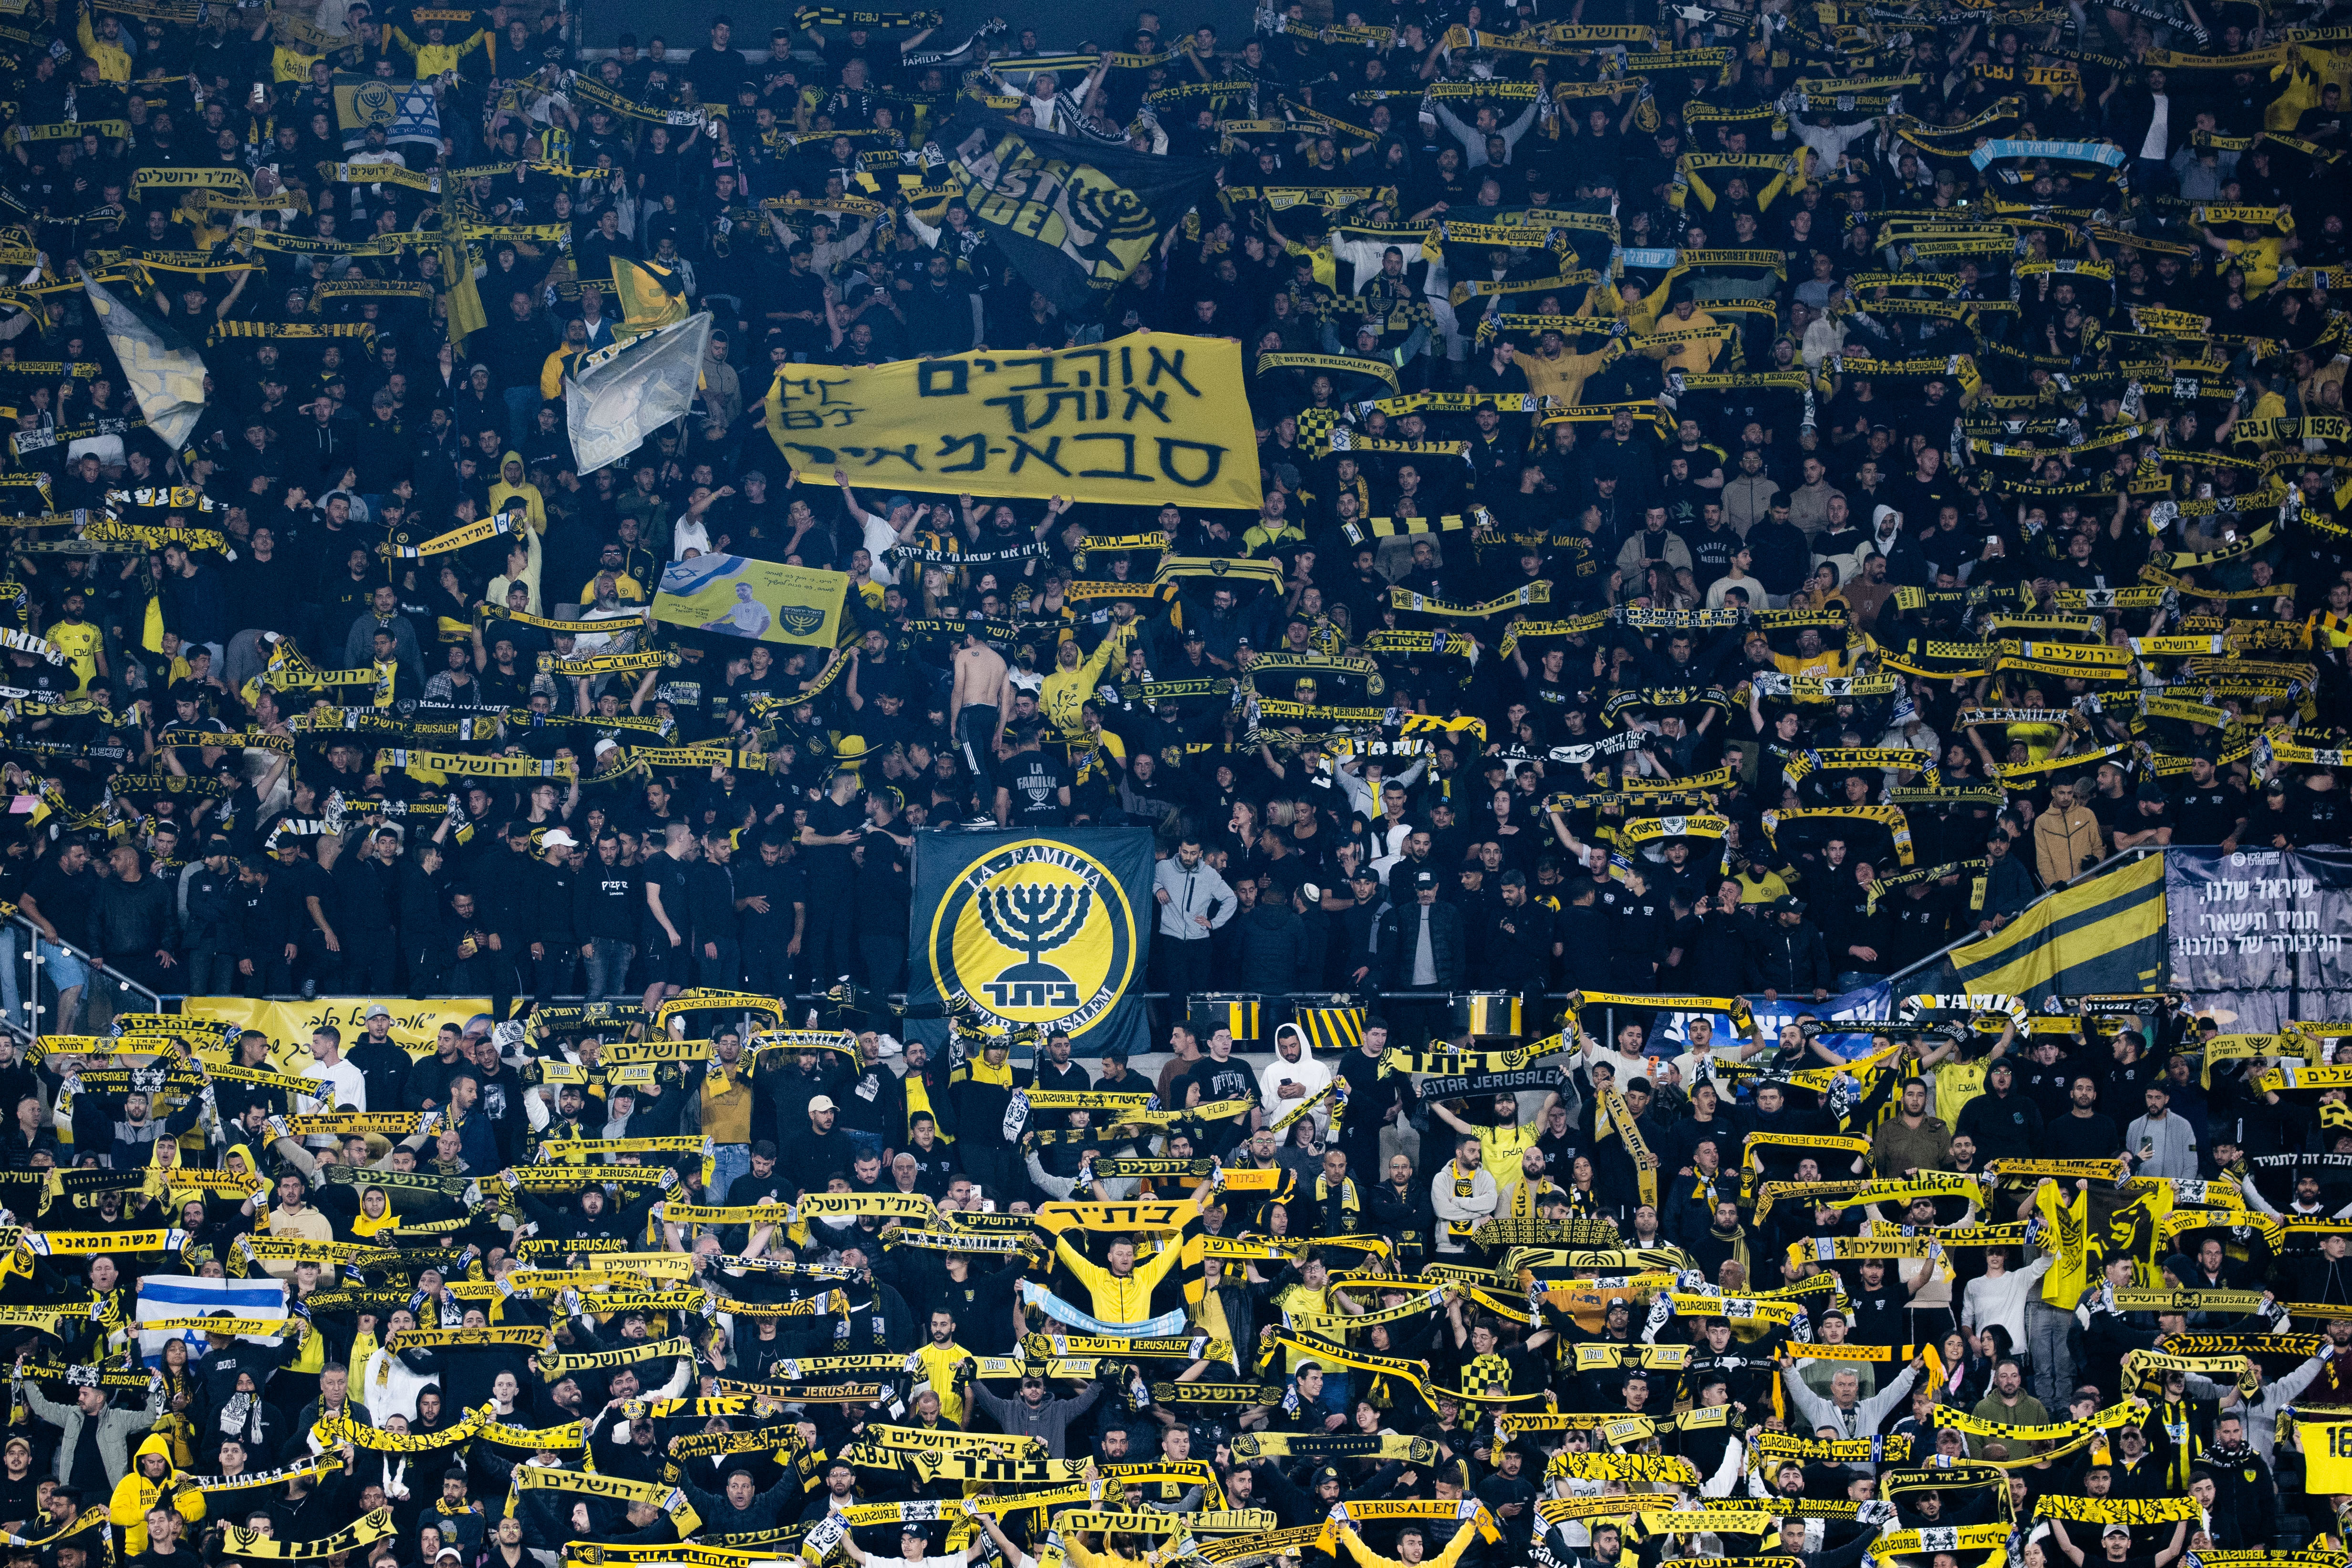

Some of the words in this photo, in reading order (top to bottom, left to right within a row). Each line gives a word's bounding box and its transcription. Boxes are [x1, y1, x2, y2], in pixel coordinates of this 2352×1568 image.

[853, 13, 879, 22] FCBJ
[1562, 27, 1639, 38] ירושלים
[902, 54, 942, 66] FAMILIA
[2214, 54, 2260, 63] JERUSALEM
[2261, 53, 2277, 62] FC
[1690, 155, 1770, 166] ירושלים
[138, 170, 198, 185] ירושלים
[204, 171, 242, 187] בית"ר
[2214, 208, 2270, 219] ירושלים
[1284, 356, 1317, 365] BEITAR
[1319, 358, 1371, 371] JERUSALEM
[1843, 359, 1878, 371] ירושלים
[1906, 359, 1948, 371] JERUSALEM
[918, 346, 1202, 398] אוהבים
[1684, 374, 1731, 385] ירושלים
[1425, 404, 1471, 412] JERUSALEM
[2311, 418, 2343, 435] 1936
[1372, 438, 1450, 451] ירושלים
[2131, 479, 2167, 490] בית"ר
[467, 523, 493, 536] בית"ר
[897, 545, 922, 557] יירא
[926, 548, 943, 561] לא
[1626, 609, 1690, 618] ירושלים
[1694, 609, 1738, 618] בית"ר
[528, 617, 567, 629] BEITAR
[570, 620, 636, 631] JERUSALEM
[945, 621, 965, 632] של
[1627, 617, 1677, 625] 2022-2023
[1704, 616, 1738, 625] מחזיקת
[2153, 639, 2198, 651] ירושלים
[2043, 647, 2114, 659] ירושלים
[286, 670, 365, 684] ירושלים
[1144, 682, 1209, 696] ירושלים
[1260, 701, 1304, 714] ירושלים
[1335, 708, 1384, 718] JERUSALEM
[619, 716, 662, 726] JERUSALEM
[1963, 709, 1976, 723] LA
[1994, 709, 2069, 723] FAMILIA
[360, 715, 407, 731] ירושלים
[413, 723, 458, 733] JERUSALEM
[1596, 734, 1624, 751] DON'T
[1626, 730, 1647, 742] FUCK
[90, 748, 124, 758] 1936
[1604, 742, 1626, 755] WITH
[1627, 740, 1640, 750] US!
[432, 757, 517, 774] ירושלים
[1031, 763, 1043, 774] LA
[1017, 774, 1057, 789] FAMILIA
[1685, 769, 1727, 785] בית"ר
[1627, 777, 1681, 790] ירושלים
[346, 801, 379, 811] ירושלים
[409, 804, 447, 813] JERUSALEM
[964, 865, 997, 892] LA
[1010, 846, 1103, 890] FAMILIA
[2198, 880, 2249, 904] שלנו,
[2256, 878, 2314, 899] שיראל
[2200, 913, 2267, 932] תישארי
[2274, 910, 2319, 930] תמיד
[2178, 936, 2229, 956] כולנו!
[2234, 936, 2262, 955] של
[2272, 935, 2342, 955] הגיבורה
[982, 983, 1080, 1007] ביתר
[58, 1043, 83, 1051] למות
[129, 1044, 155, 1052] אותך
[615, 1044, 702, 1060] ירושלים
[25, 1052, 40, 1066] 2005
[1402, 1052, 1490, 1075] ביתר
[550, 1066, 570, 1076] שלנו
[624, 1068, 648, 1077] הגביע
[1207, 1103, 1229, 1114] FCBJ
[299, 1115, 355, 1126] ירושלים
[361, 1114, 405, 1124] בית"ר
[305, 1125, 337, 1133] BEITAR
[348, 1125, 402, 1133] JERUSALEM
[554, 1139, 622, 1152] ירושלים
[649, 1136, 702, 1148] בית"ר
[2254, 1153, 2298, 1167] לתמיד
[2302, 1153, 2320, 1165] זה
[2324, 1154, 2352, 1165] הבה
[518, 1166, 572, 1178] ירושלים
[597, 1166, 662, 1179] JERUSALEM
[1119, 1161, 1188, 1173] ירושלים
[876, 1197, 927, 1214] בית"ר
[670, 1207, 725, 1220] ירושלים
[746, 1204, 787, 1220] בית"ר
[967, 1215, 1019, 1225] ירושלים
[2174, 1217, 2197, 1230] למות
[57, 1235, 111, 1248] חמאני
[119, 1234, 156, 1246] משה
[904, 1228, 930, 1247] LA
[935, 1234, 1017, 1253] FAMILIA
[253, 1243, 295, 1254] ירושלים
[1854, 1241, 1910, 1254] ירושלים
[604, 1259, 651, 1270] ירושלים
[657, 1259, 689, 1271] בית"ר
[515, 1271, 579, 1285] ירושלים
[2117, 1294, 2170, 1302] ירושלים
[2202, 1295, 2262, 1304] JERUSALEM
[166, 1319, 219, 1327] ירושלים
[224, 1320, 263, 1330] בית"ר
[1070, 1338, 1126, 1348] ירושלים
[1133, 1340, 1188, 1350] JERUSALEM
[1296, 1334, 1358, 1359] ירושלים
[2165, 1336, 2246, 1353] ירושלים
[2265, 1336, 2320, 1349] בית"ר
[566, 1351, 640, 1369] ירושלים
[1584, 1349, 1604, 1359] שלנו
[1658, 1351, 1680, 1360] הגביע
[813, 1356, 893, 1369] ירושלים
[985, 1359, 1006, 1370] שלנו
[1066, 1361, 1091, 1371] הגביע
[1364, 1354, 1410, 1371] בית"ר
[102, 1375, 151, 1386] JERUSALEM
[721, 1379, 791, 1396] ירושלים
[803, 1384, 879, 1397] JERUSALEM
[1178, 1385, 1257, 1400] ירושלים
[1695, 1408, 1721, 1420] הגביע
[1611, 1423, 1635, 1435] שלנו
[954, 1460, 1050, 1481] ביתר
[1937, 1470, 1969, 1481] ב.יאיר
[544, 1475, 642, 1496] ירושלים
[1354, 1502, 1457, 1516] JERUSALEM
[1565, 1507, 1596, 1517] BEITAR
[1602, 1503, 1655, 1513] JERUSALEM
[1798, 1499, 1859, 1513] JERUSALEM
[1072, 1514, 1169, 1531] ירושלים
